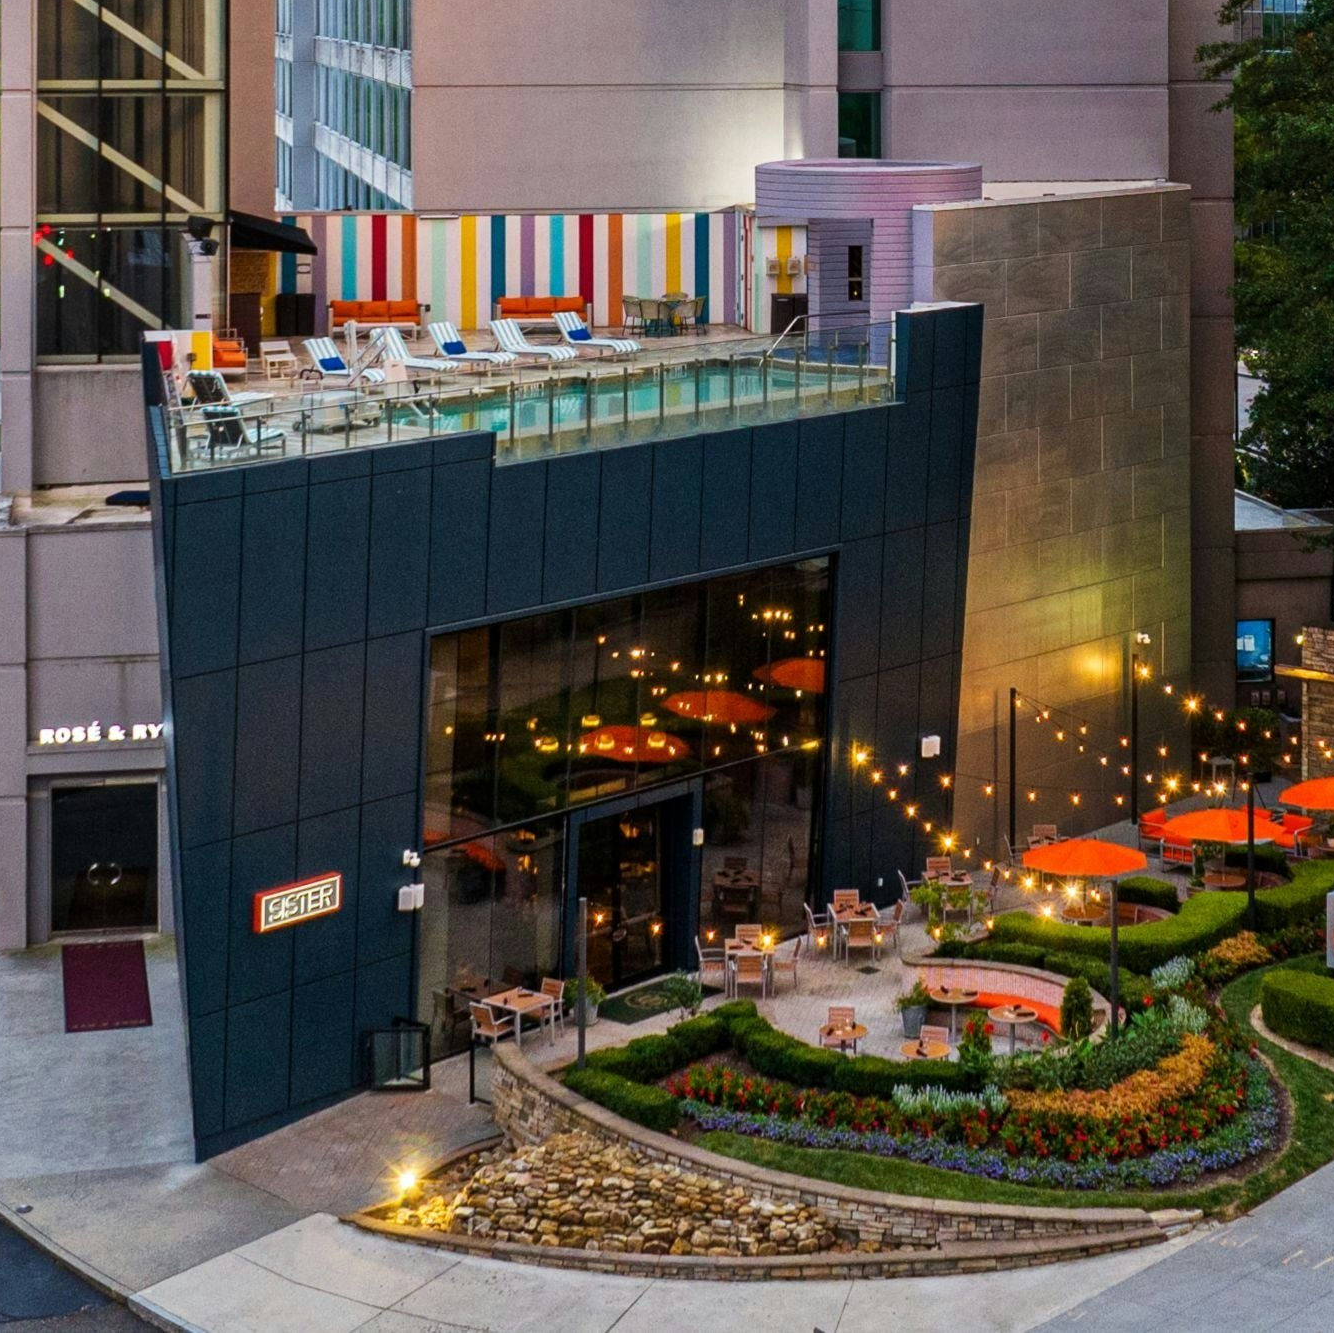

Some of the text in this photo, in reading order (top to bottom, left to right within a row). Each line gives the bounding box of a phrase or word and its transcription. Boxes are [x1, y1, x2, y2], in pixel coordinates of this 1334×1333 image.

[39, 720, 102, 744] ROSÉ
[108, 725, 126, 741] &
[269, 884, 334, 922] SISTER
